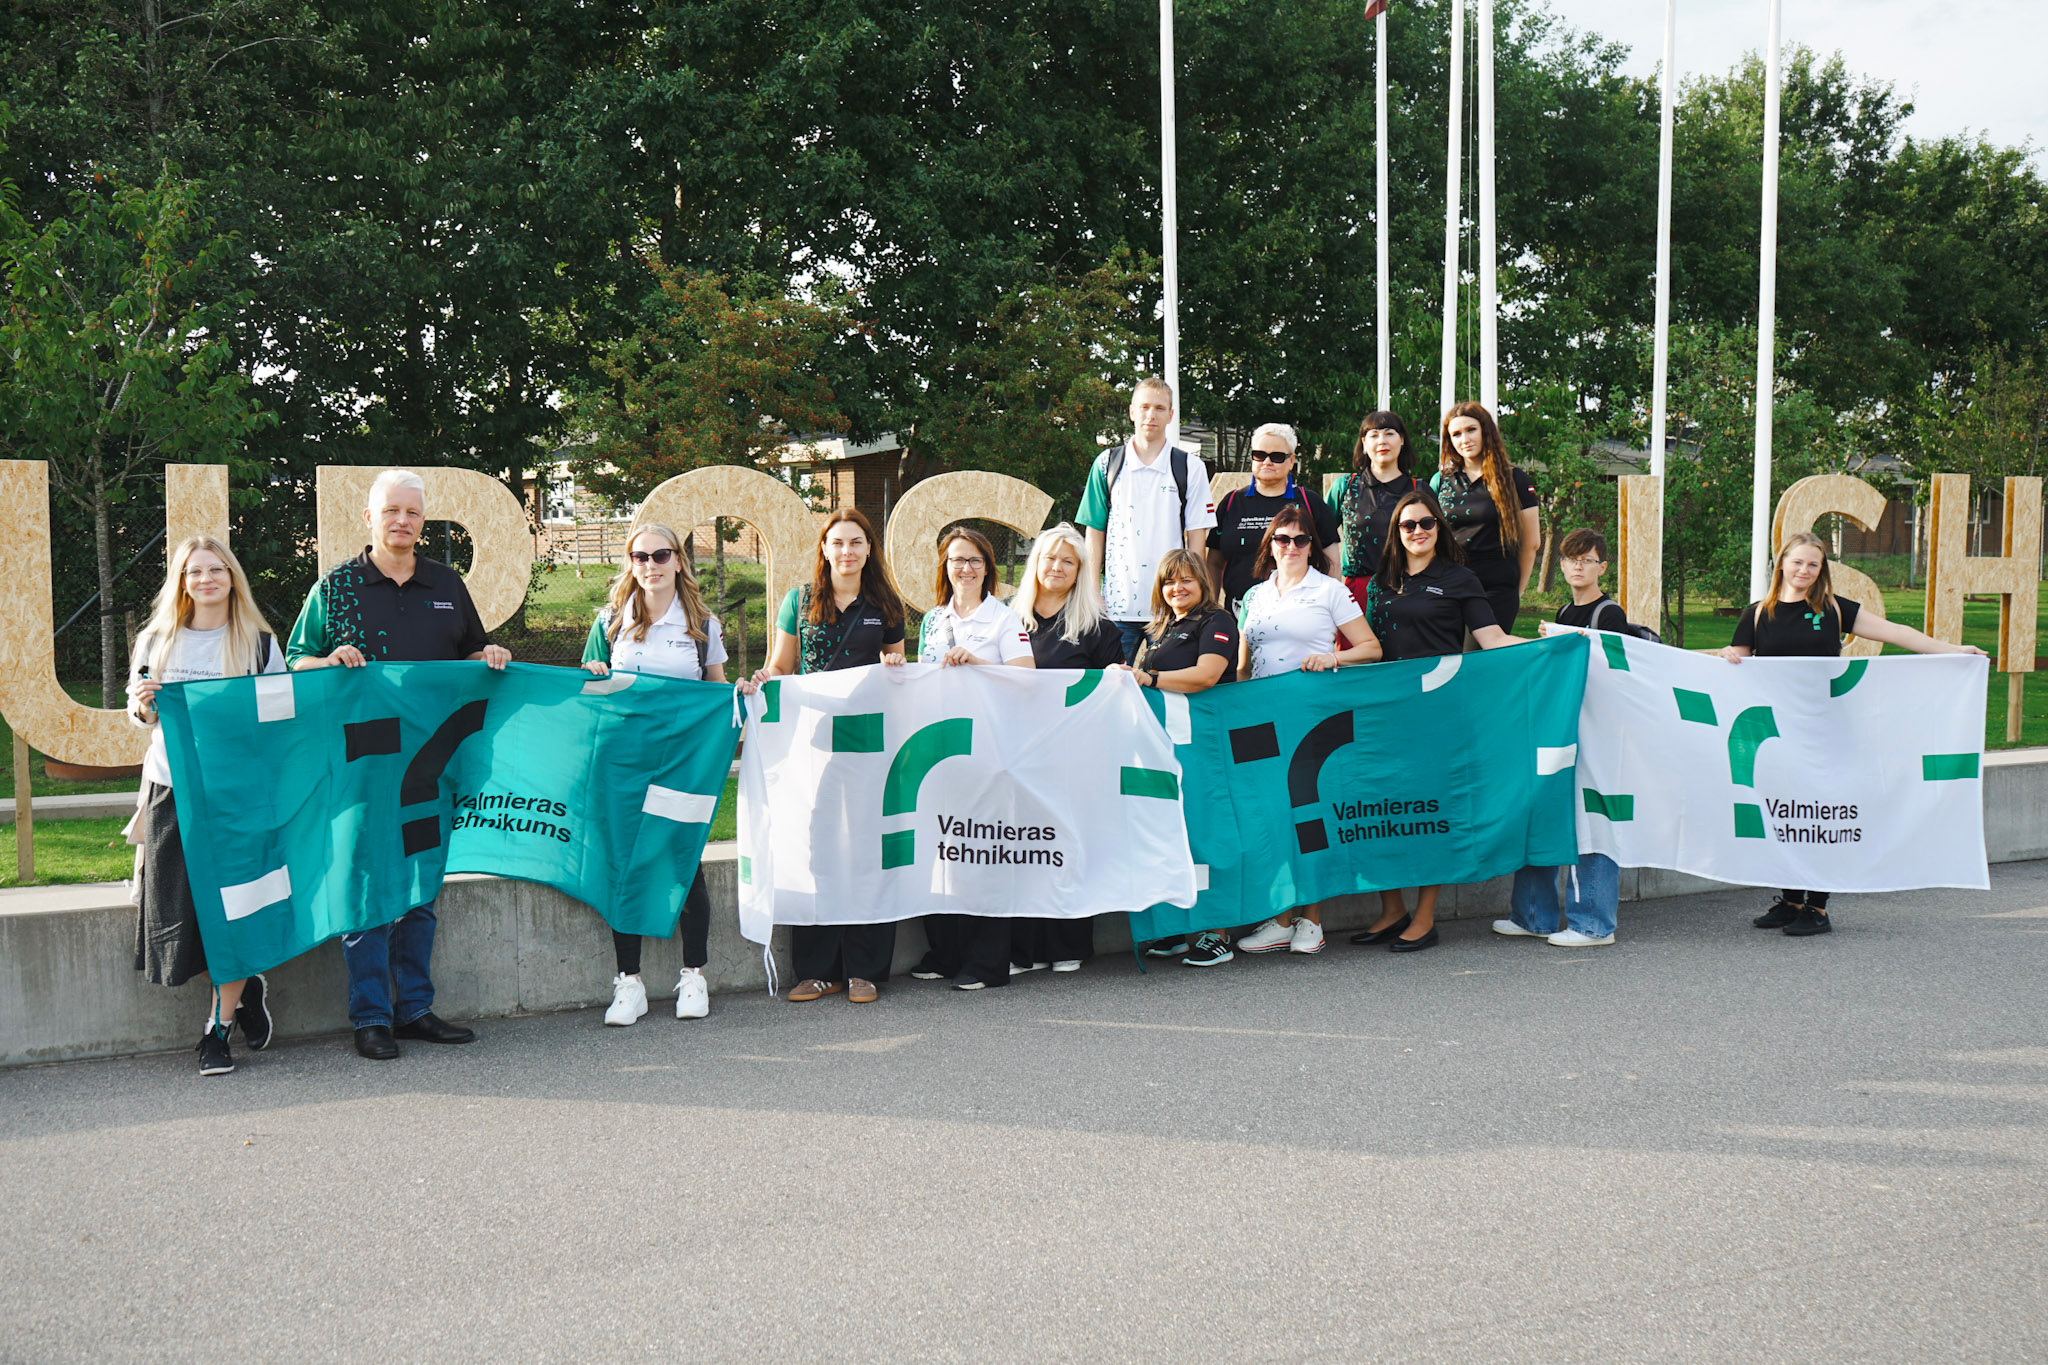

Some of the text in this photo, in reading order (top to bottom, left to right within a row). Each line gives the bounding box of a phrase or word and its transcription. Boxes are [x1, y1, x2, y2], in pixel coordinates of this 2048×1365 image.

[452, 792, 567, 817] Valmieras
[1332, 798, 1440, 821] Valmieras
[1765, 798, 1858, 820] Valmieras
[451, 811, 571, 843] ehnikums
[937, 814, 1056, 841] Valmieras
[1337, 820, 1450, 844] tehnikums
[937, 841, 1064, 868] tehnikums
